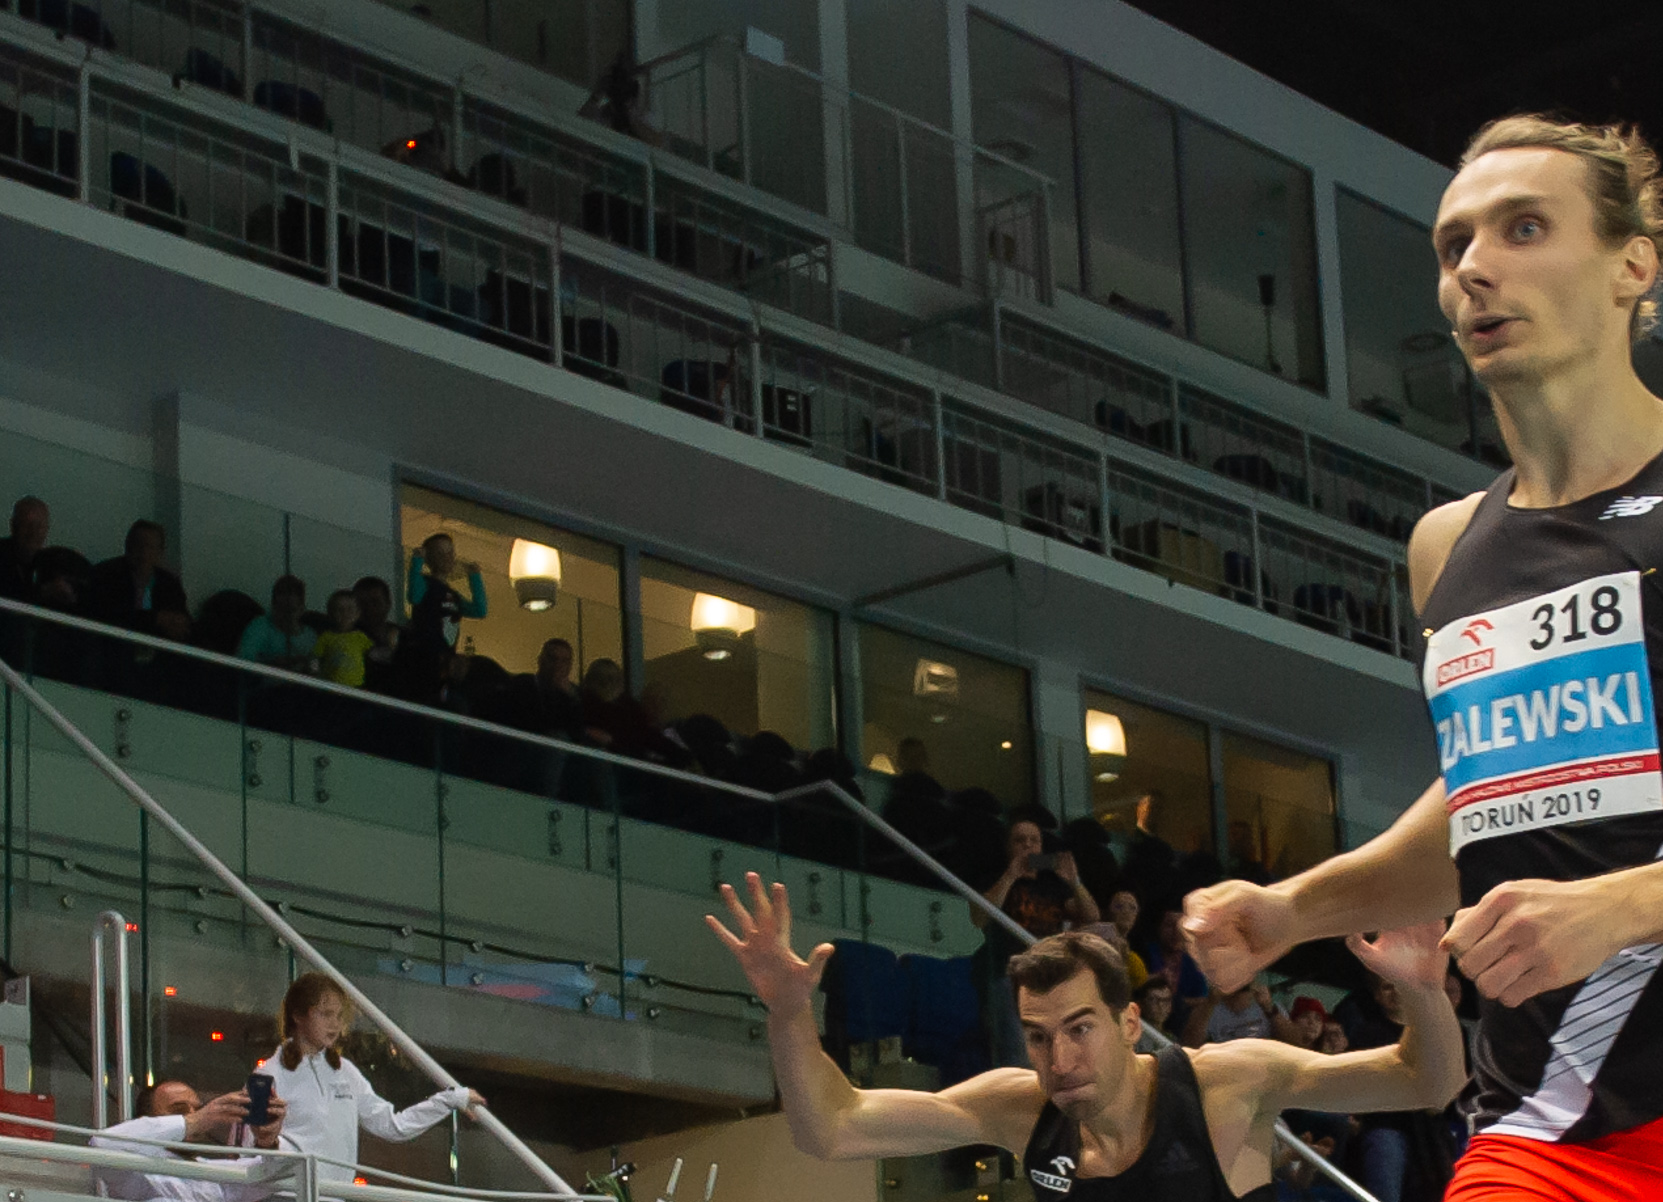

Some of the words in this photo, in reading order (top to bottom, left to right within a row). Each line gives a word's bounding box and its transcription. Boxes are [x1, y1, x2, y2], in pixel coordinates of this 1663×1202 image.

[1529, 586, 1623, 650] 318
[1437, 671, 1643, 771] ZALEWSKI
[1541, 788, 1602, 819] 2019
